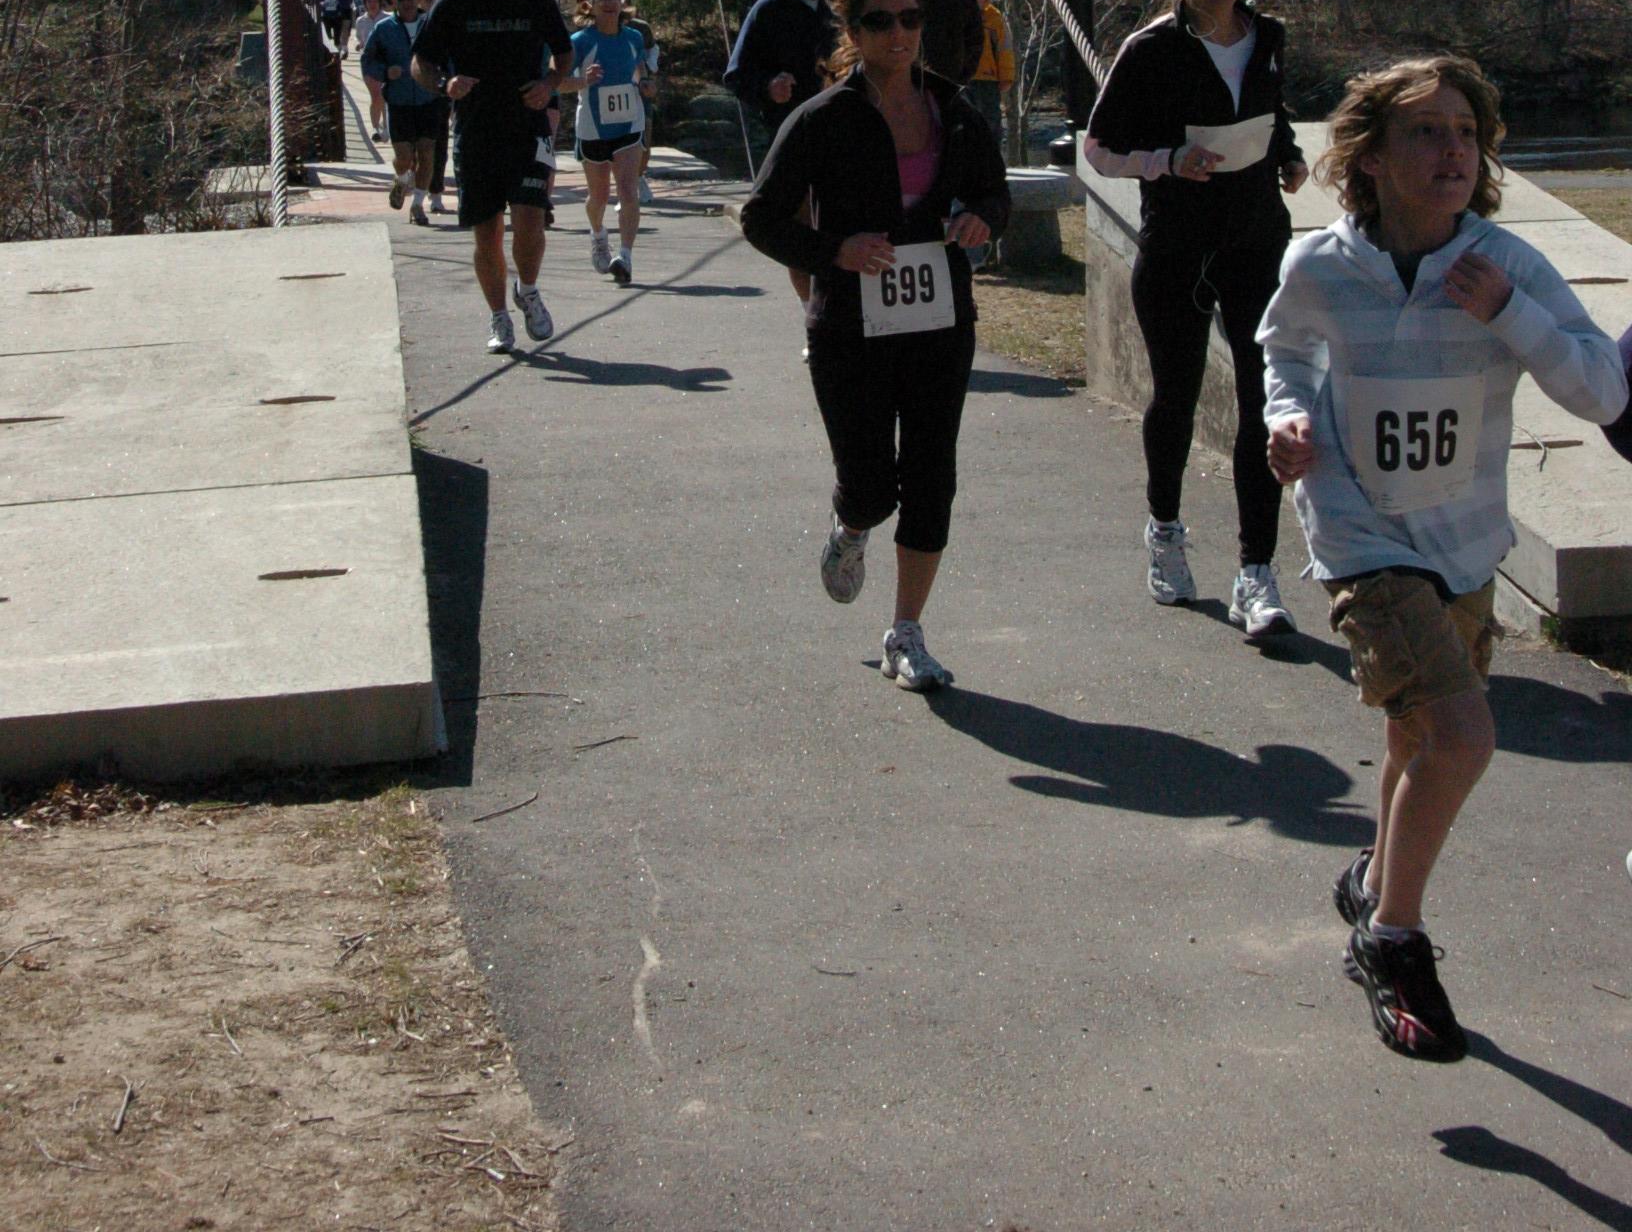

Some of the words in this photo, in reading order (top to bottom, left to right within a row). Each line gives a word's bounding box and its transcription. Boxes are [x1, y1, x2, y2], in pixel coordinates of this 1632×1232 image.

[608, 92, 630, 112] 611
[880, 263, 935, 307] 699
[1375, 408, 1459, 472] 656
